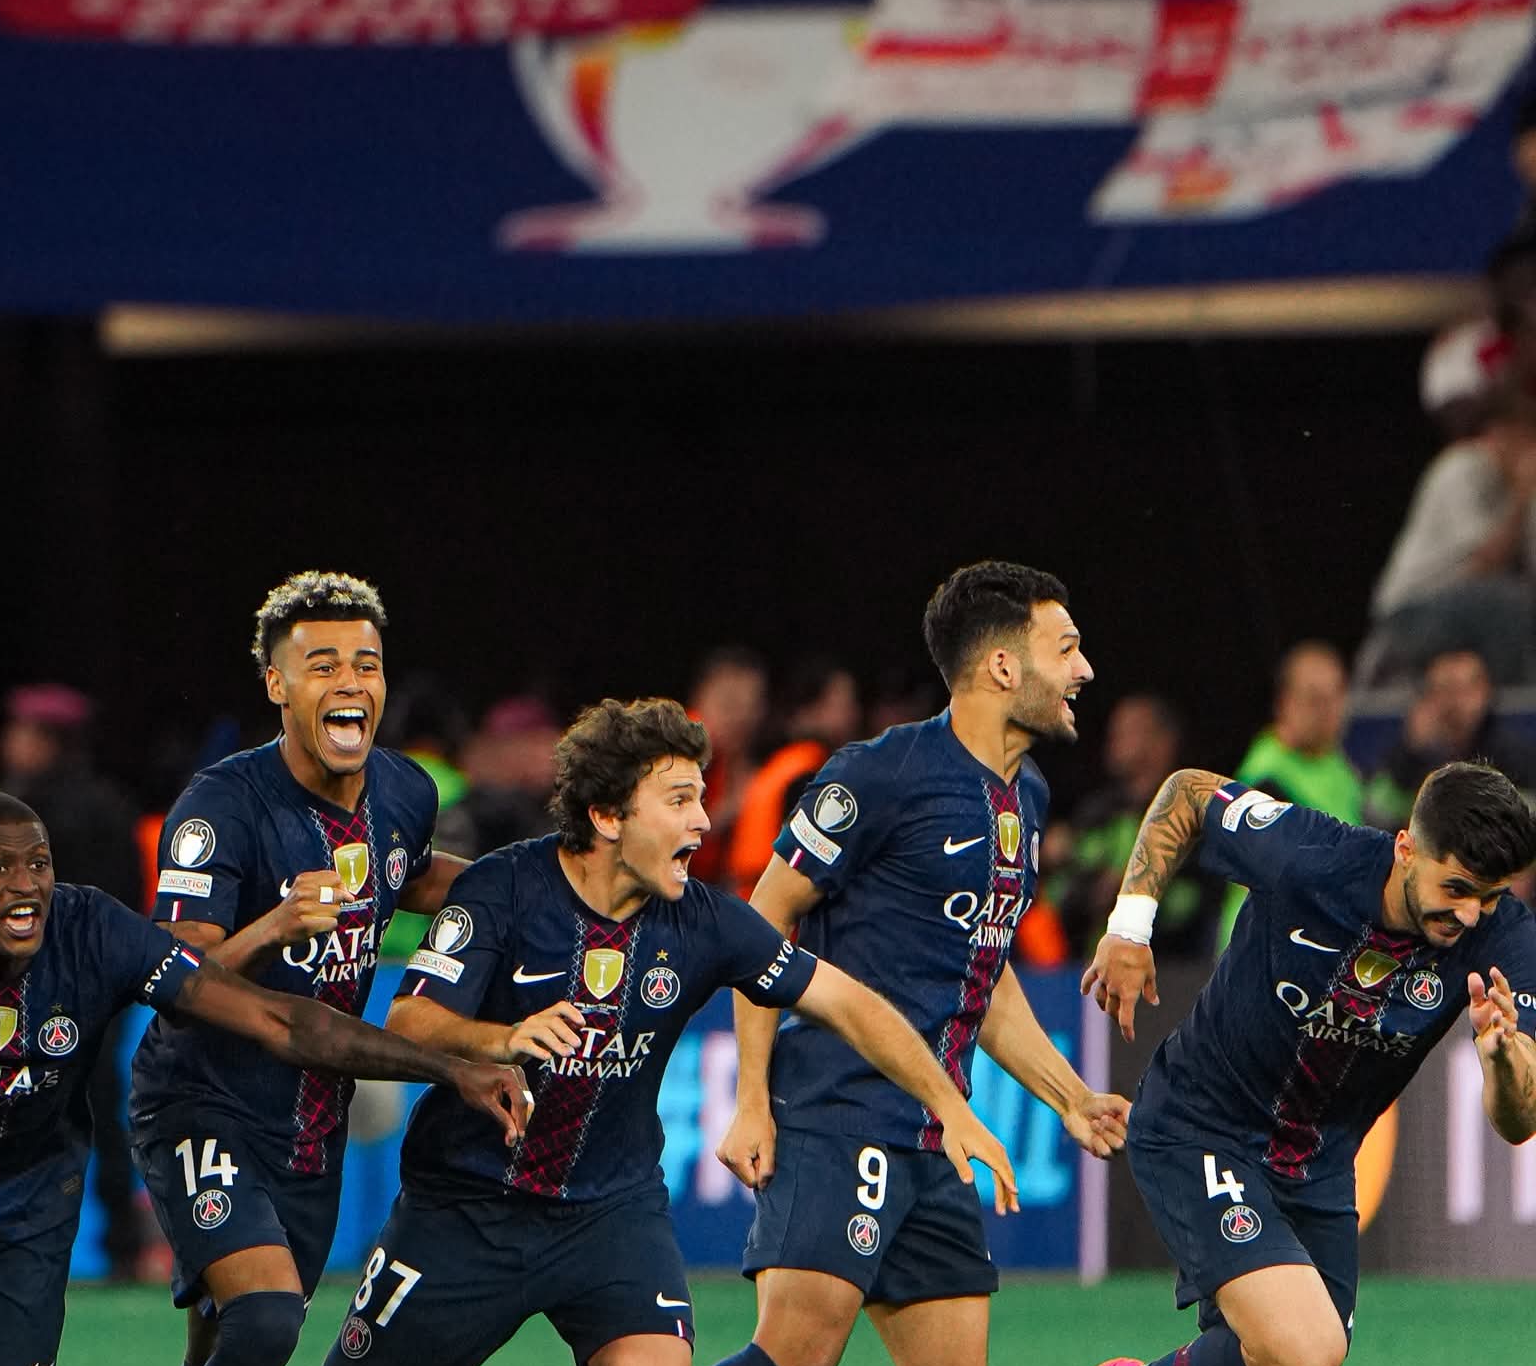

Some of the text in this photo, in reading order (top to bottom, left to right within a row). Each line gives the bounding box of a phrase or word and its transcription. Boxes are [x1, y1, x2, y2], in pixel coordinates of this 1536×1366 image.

[944, 891, 1032, 930] QATA
[647, 968, 675, 981] PARIS
[757, 938, 792, 990] BEYO
[43, 1017, 71, 1031] PARIS
[579, 1026, 656, 1059] TAR
[175, 1139, 239, 1197] 14
[857, 1146, 888, 1210] 9
[1203, 1154, 1244, 1203] 4
[355, 1246, 423, 1327] 87
